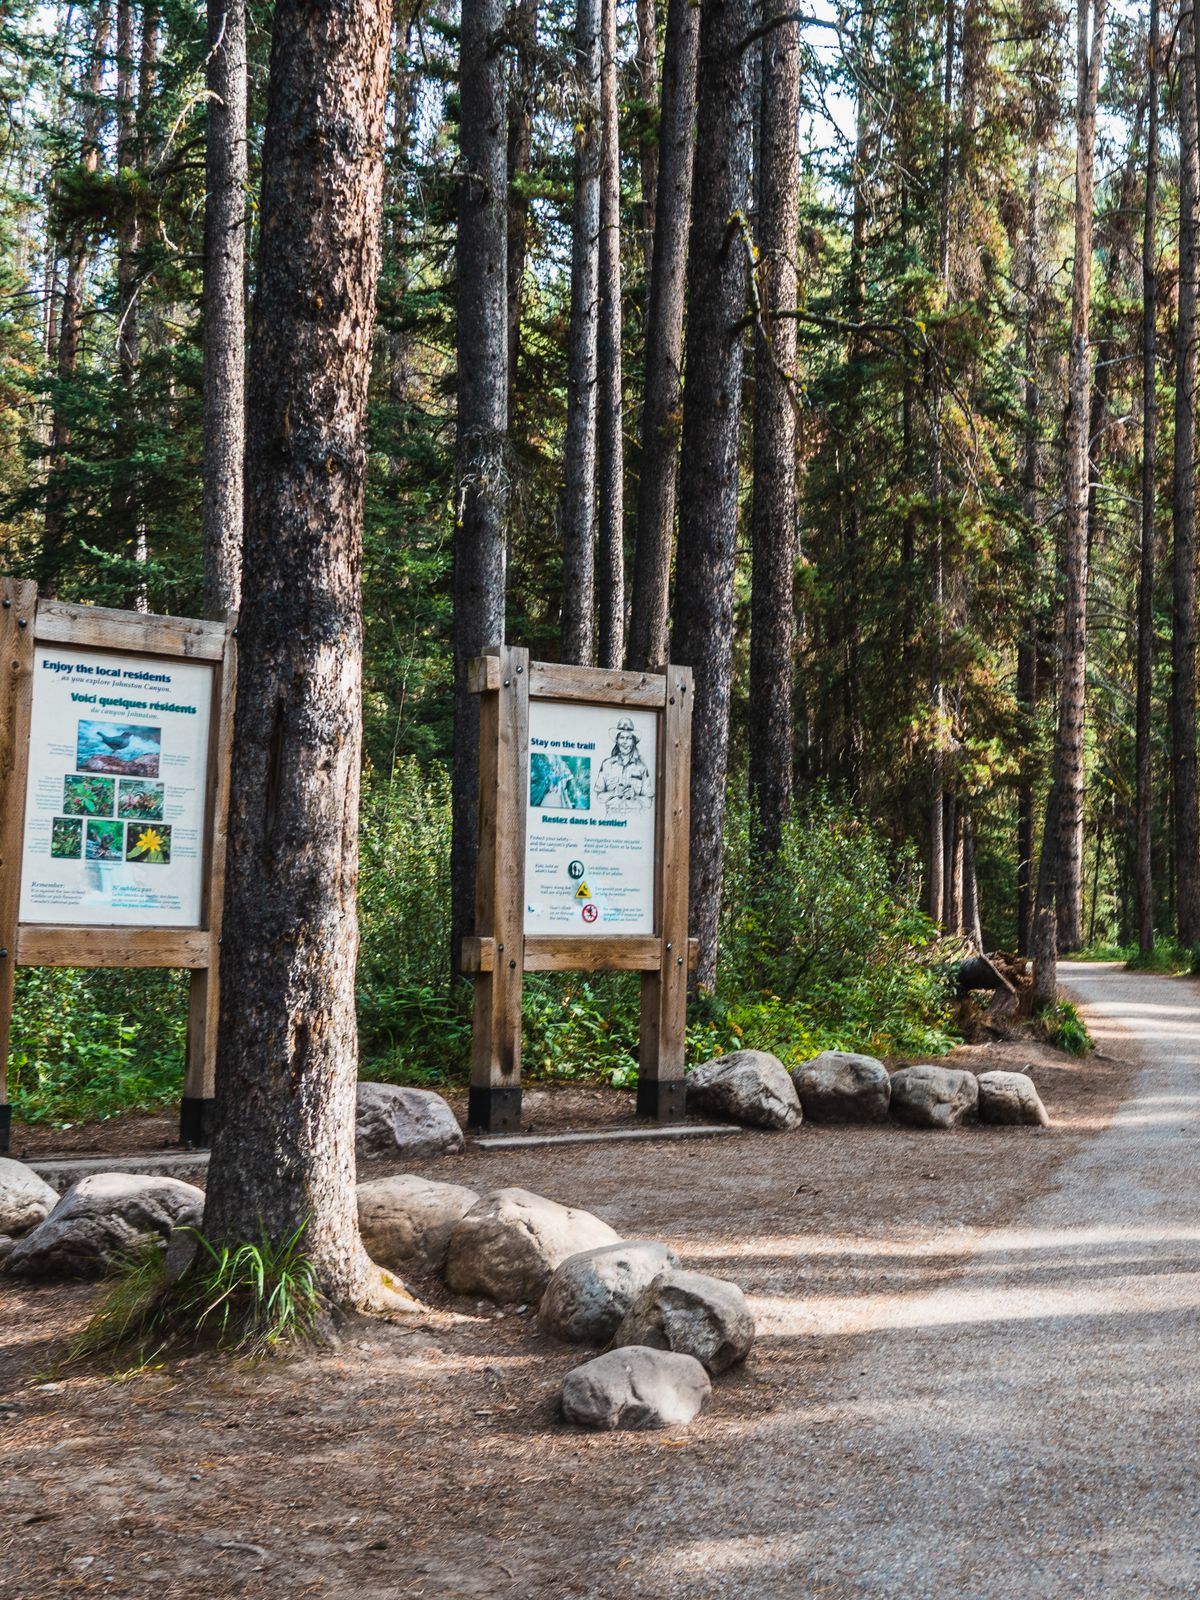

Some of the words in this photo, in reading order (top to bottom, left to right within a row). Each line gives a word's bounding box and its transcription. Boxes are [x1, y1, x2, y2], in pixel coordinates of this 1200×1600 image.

[43, 660, 73, 674] Enjoy
[76, 664, 94, 674] the
[96, 666, 121, 677] local
[123, 670, 172, 683] residents
[86, 678, 110, 686] explore
[112, 680, 143, 689] Johnston
[71, 692, 97, 704] Voici
[99, 696, 147, 710] quelques
[149, 700, 197, 714] résidents
[531, 737, 549, 748] Stay
[562, 740, 575, 748] the
[577, 742, 595, 750] trail!
[542, 815, 568, 824] Restez
[569, 816, 588, 825] dans
[598, 819, 627, 827] sentier!
